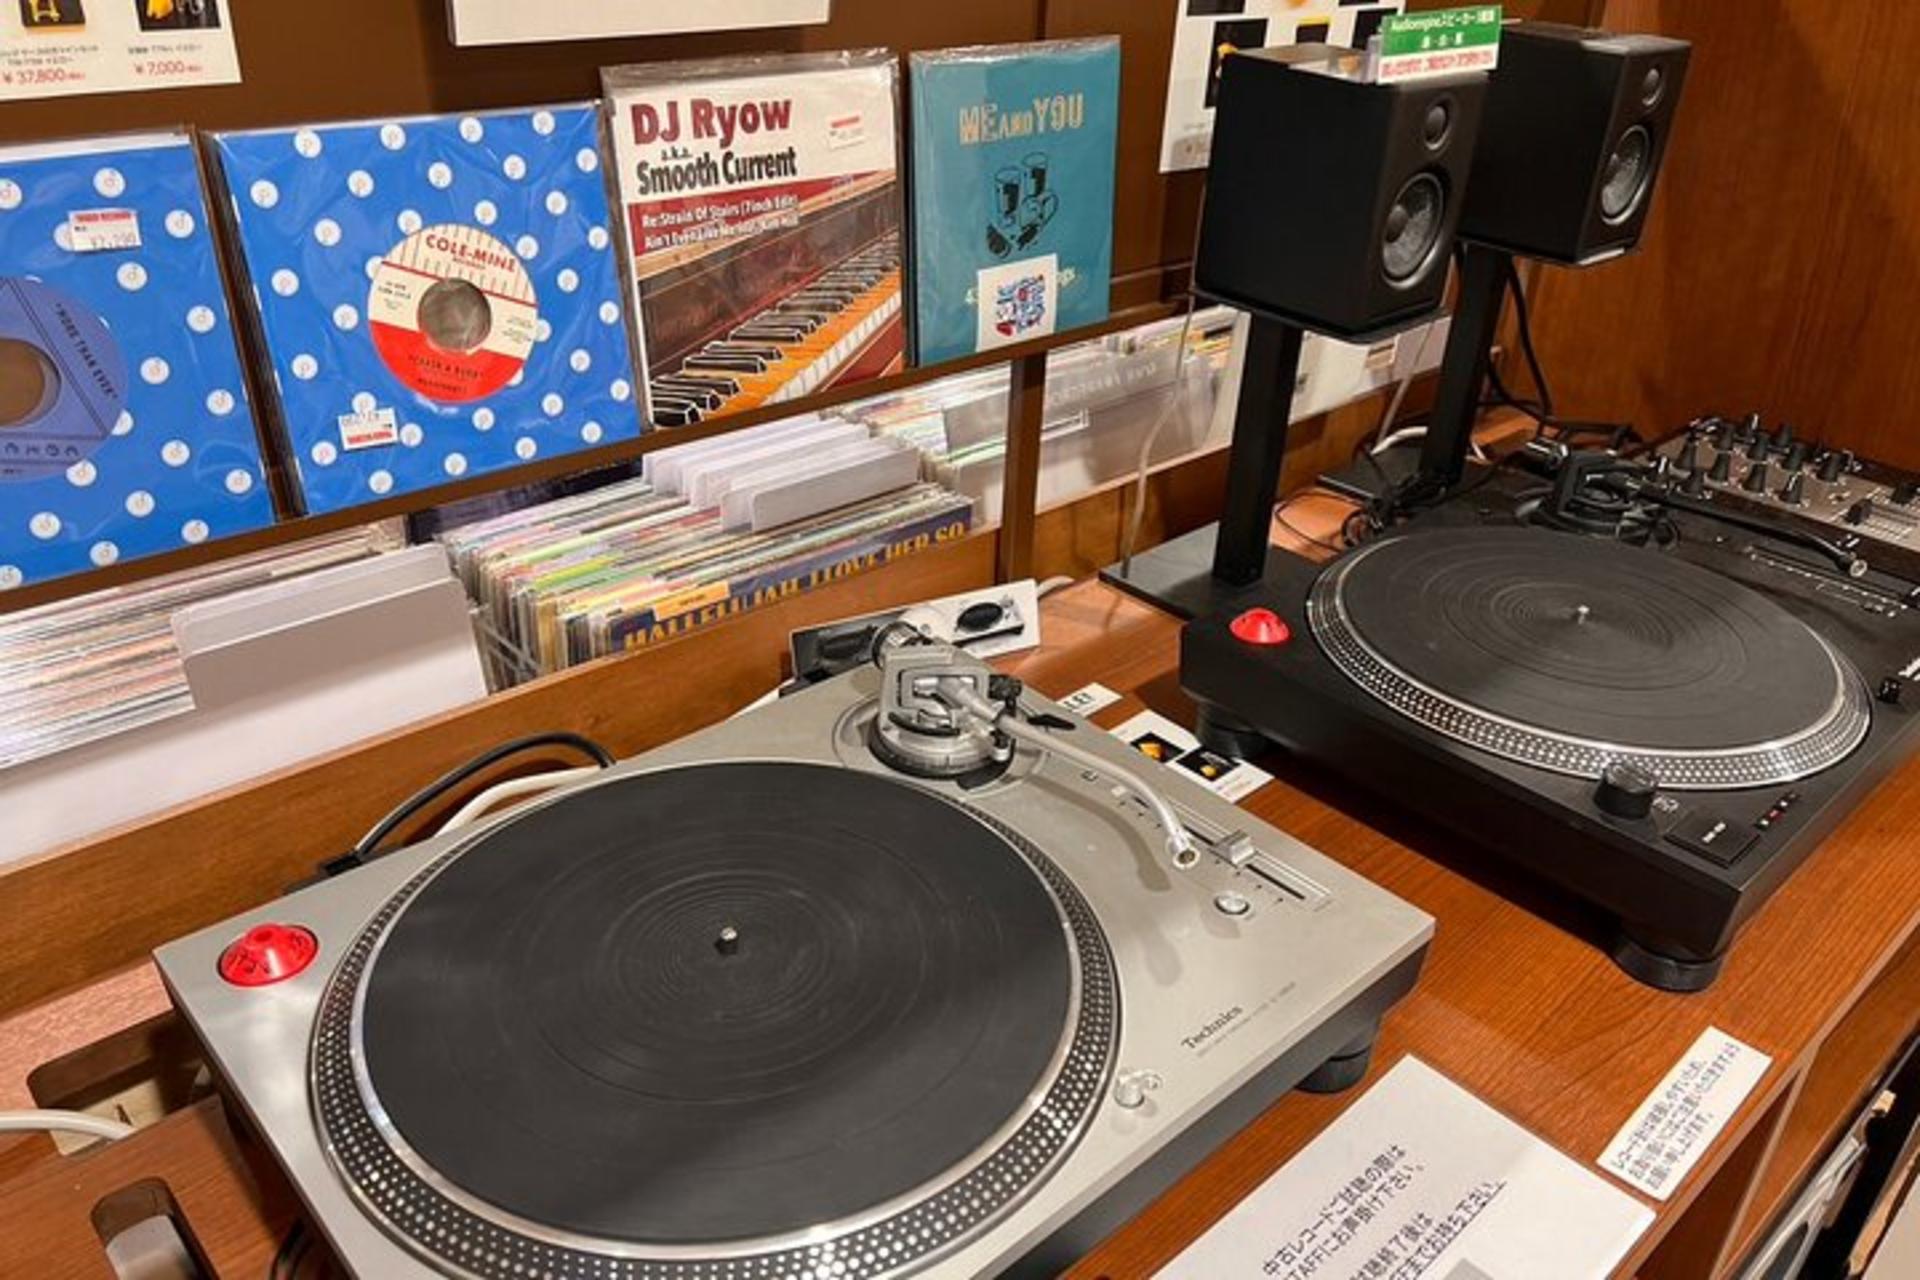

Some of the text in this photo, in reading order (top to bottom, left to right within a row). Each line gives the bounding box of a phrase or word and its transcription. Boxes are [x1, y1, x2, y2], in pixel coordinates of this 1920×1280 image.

[631, 99, 792, 148] DJ Ryow
[1032, 93, 1083, 132] YOU
[637, 146, 797, 196] Smooth Current
[426, 233, 516, 273] COLE-MINE
[934, 520, 966, 542] SO
[1181, 1006, 1243, 1049] Technics
[1263, 1144, 1406, 1275] 中古レコードご試聴の際は
[1281, 1163, 1425, 1280] TAFFにお声掛け下さい。
